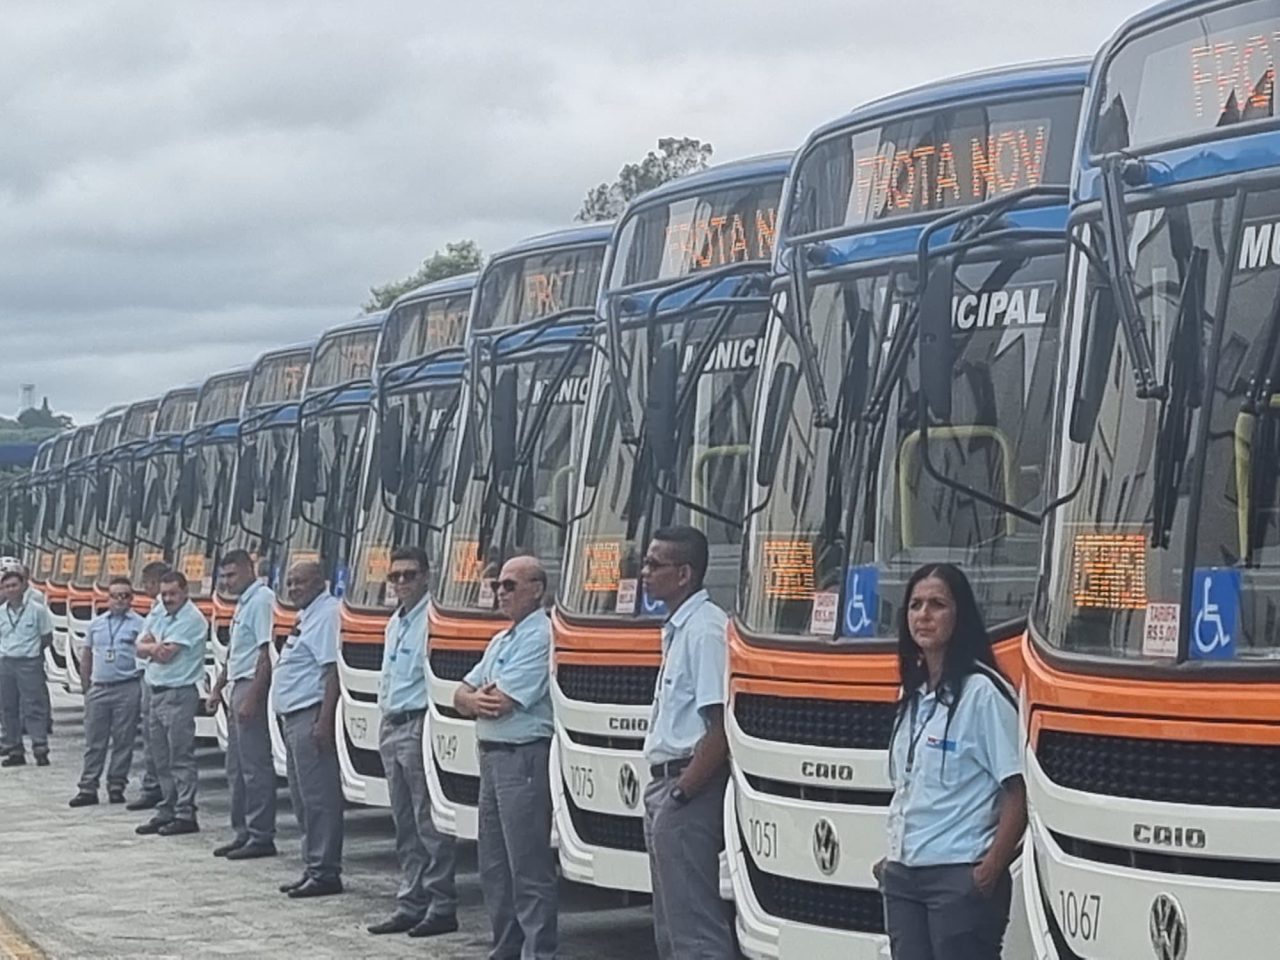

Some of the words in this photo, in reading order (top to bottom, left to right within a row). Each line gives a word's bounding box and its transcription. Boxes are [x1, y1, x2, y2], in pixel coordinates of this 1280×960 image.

[855, 142, 961, 215] FROTA
[608, 716, 649, 732] CAIO
[569, 764, 595, 800] 1075
[801, 760, 854, 781] CAIO
[748, 817, 778, 859] 1051
[1132, 823, 1206, 849] CAIO
[1059, 889, 1102, 942] 1067
